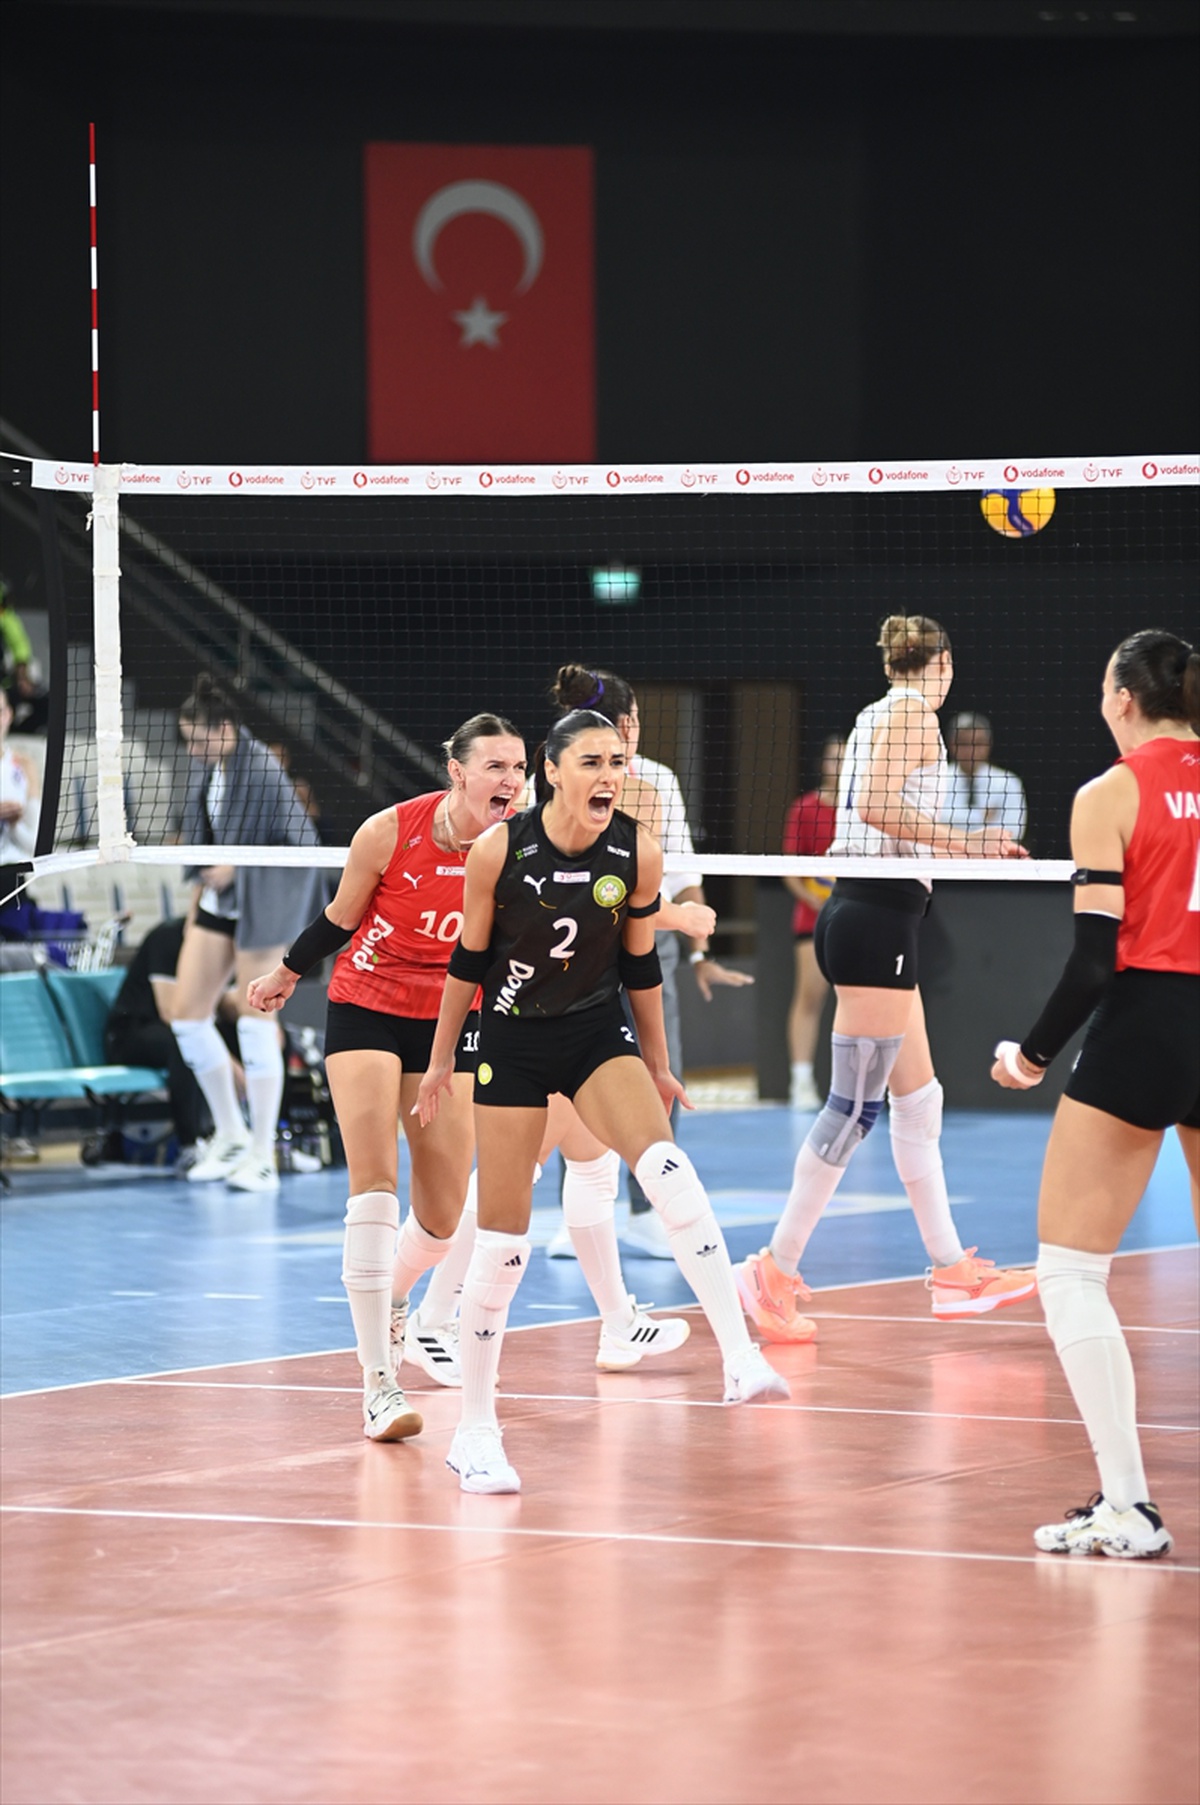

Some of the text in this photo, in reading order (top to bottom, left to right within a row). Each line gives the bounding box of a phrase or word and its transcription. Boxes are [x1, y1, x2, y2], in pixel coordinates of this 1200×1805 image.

[72, 473, 89, 483] TVF
[122, 473, 160, 483] vodafone
[192, 476, 212, 485] TVF
[246, 474, 284, 485] vodafone
[317, 477, 336, 486] TVF
[370, 474, 409, 485] vodafone
[442, 477, 462, 485] TVF
[496, 473, 535, 484] vodafone
[568, 476, 589, 485] TVF
[623, 473, 664, 483] vodafone
[698, 474, 718, 484] TVF
[752, 471, 794, 482] vodafone
[829, 473, 850, 482] TVF
[886, 469, 928, 481] vodafone
[964, 471, 984, 481] TVF
[1020, 466, 1065, 478] vodafone
[1101, 468, 1122, 478] TVF
[1164, 791, 1200, 819] VA
[414, 910, 464, 943] 10
[550, 917, 578, 959] 2
[895, 954, 904, 976] 1
